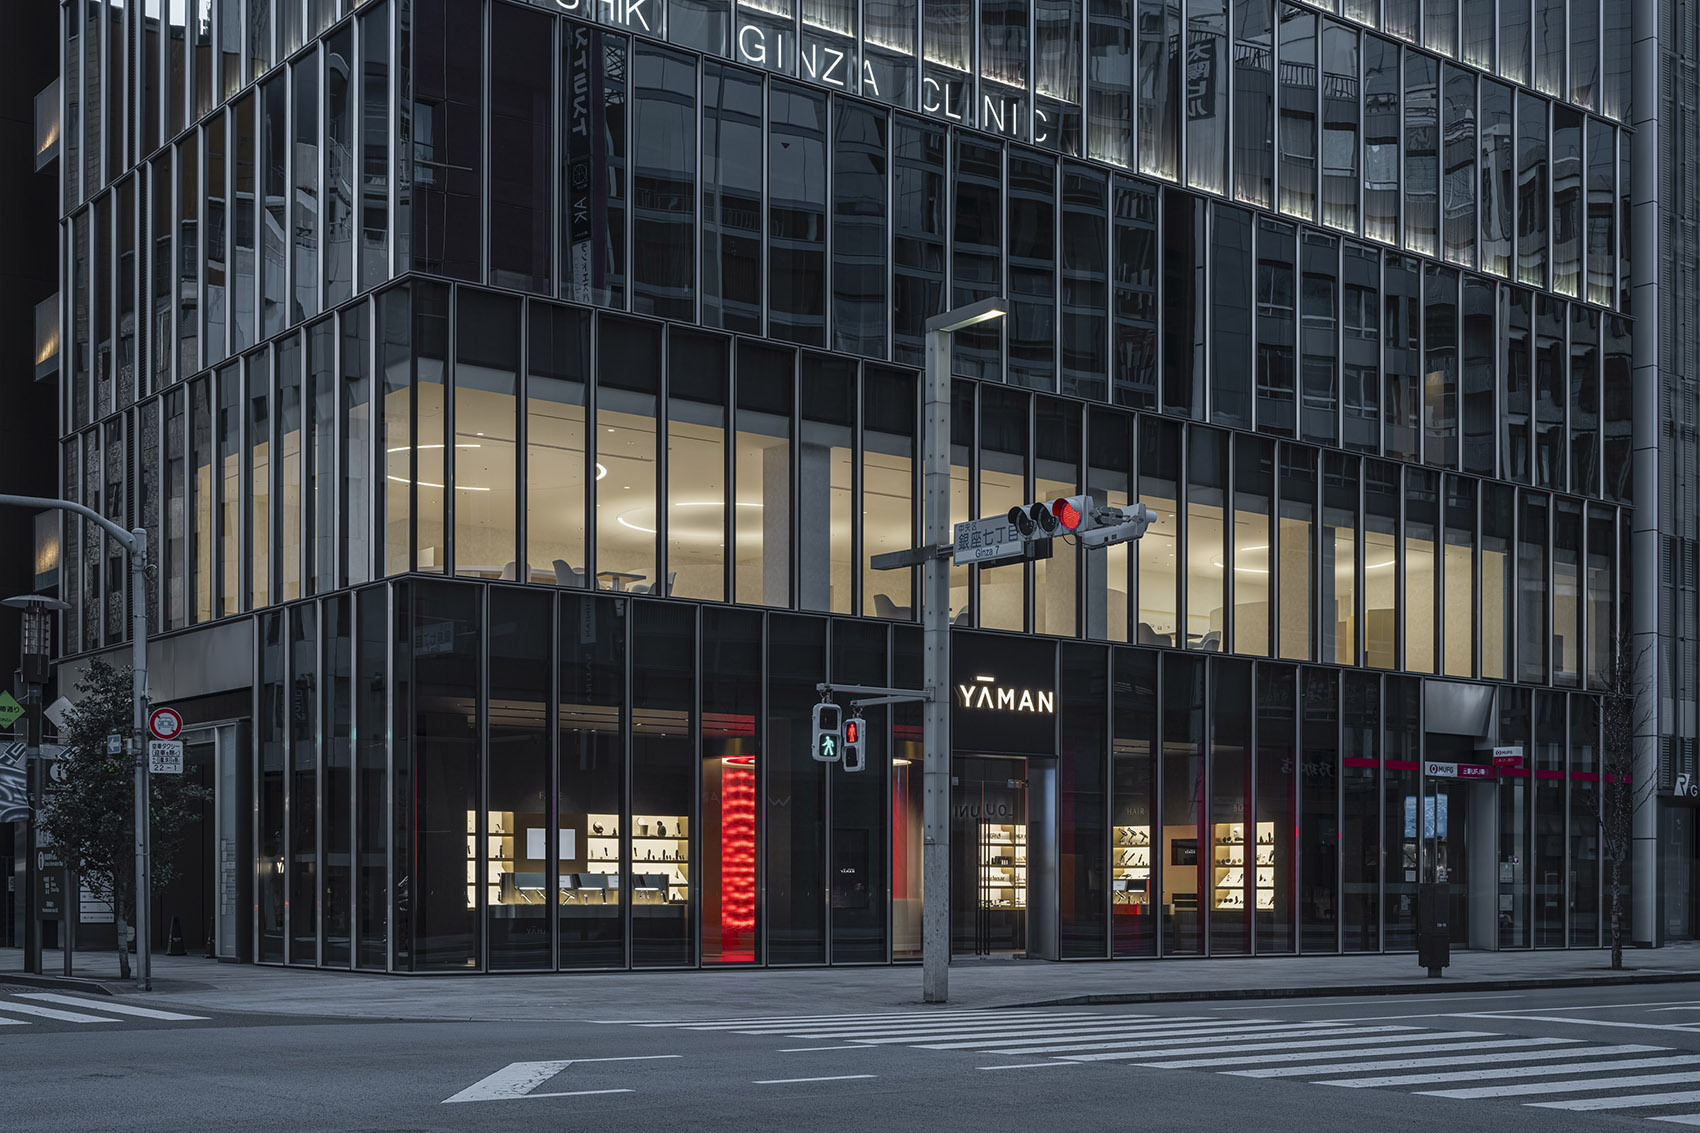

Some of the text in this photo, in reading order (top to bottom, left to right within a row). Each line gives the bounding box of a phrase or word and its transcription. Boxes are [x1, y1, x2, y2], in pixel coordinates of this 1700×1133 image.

[738, 24, 880, 96] GINZA
[922, 77, 1048, 142] CLINIC
[958, 525, 1019, 551] 銀座七丁目
[976, 545, 1000, 558] Ginza 7
[1438, 766, 1454, 774] MUFG
